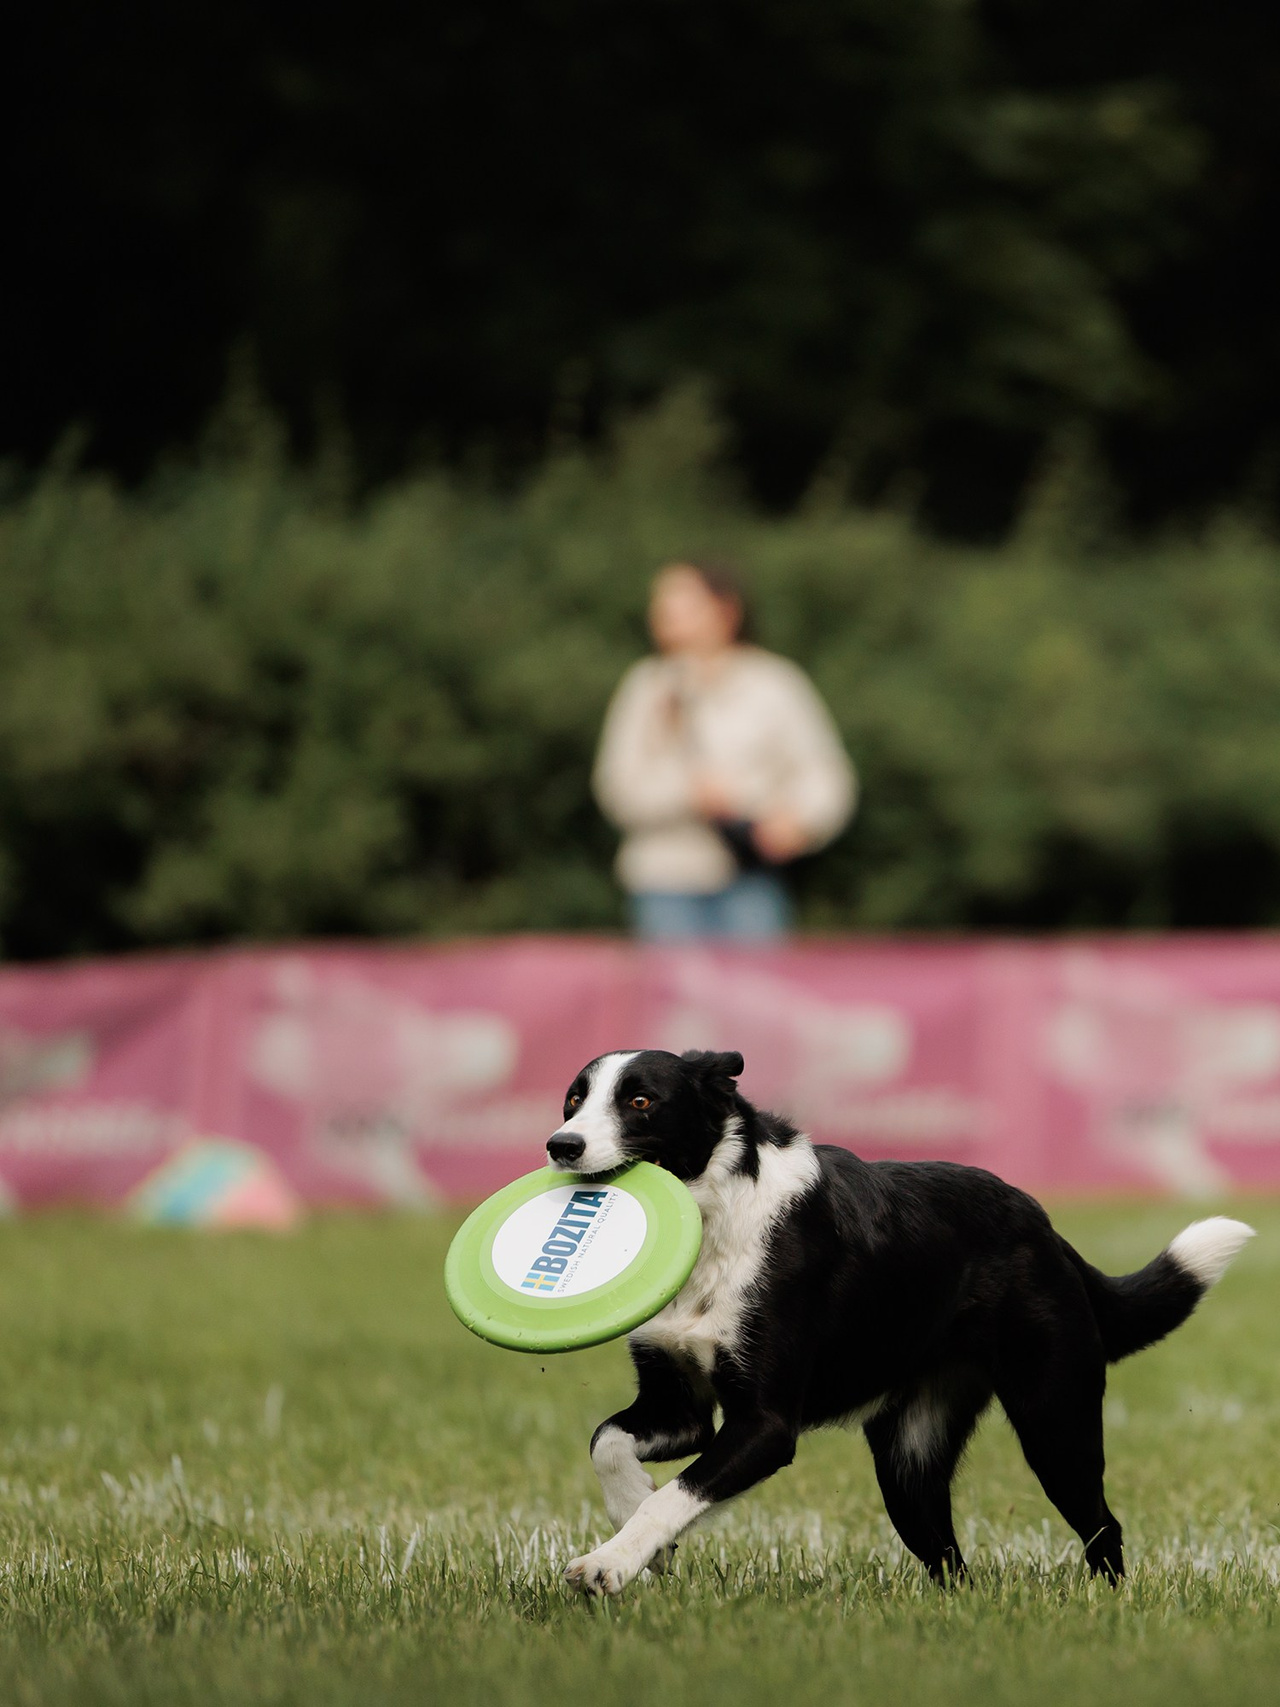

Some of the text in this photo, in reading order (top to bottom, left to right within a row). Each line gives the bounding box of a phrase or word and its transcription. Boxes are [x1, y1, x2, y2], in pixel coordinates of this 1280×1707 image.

[530, 1190, 609, 1275] BOZITA
[557, 1192, 619, 1293] SWEDISH NATURAL QUALITY
